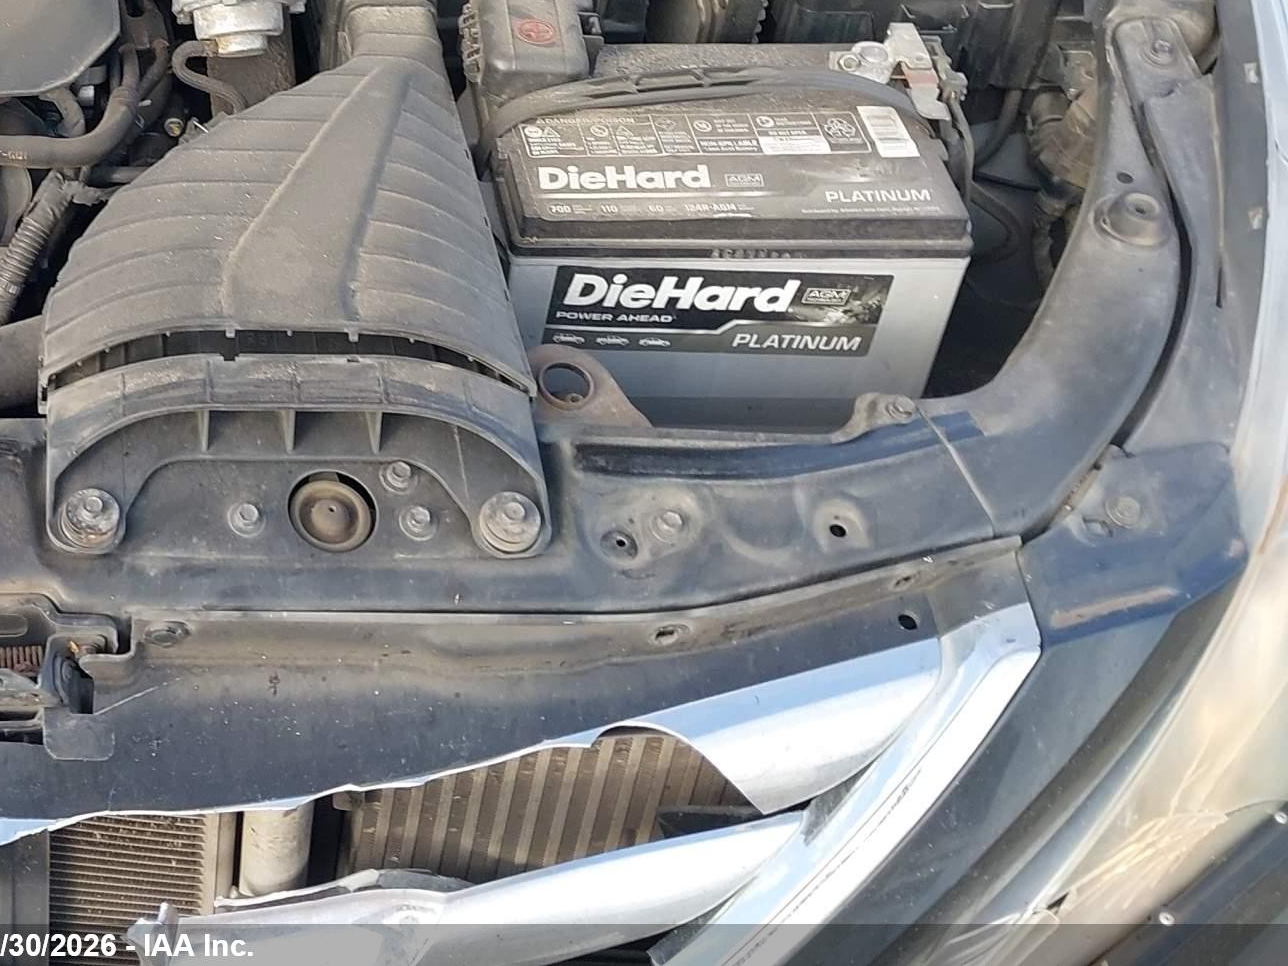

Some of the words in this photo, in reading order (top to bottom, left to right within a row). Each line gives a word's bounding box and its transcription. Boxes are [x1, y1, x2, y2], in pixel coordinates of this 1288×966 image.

[538, 165, 712, 190] DieHard
[825, 189, 932, 203] PLATINUM
[562, 273, 802, 313] DieHard
[556, 310, 613, 322] POWER
[615, 313, 674, 323] AHEAD
[732, 333, 862, 352] PLATINUM
